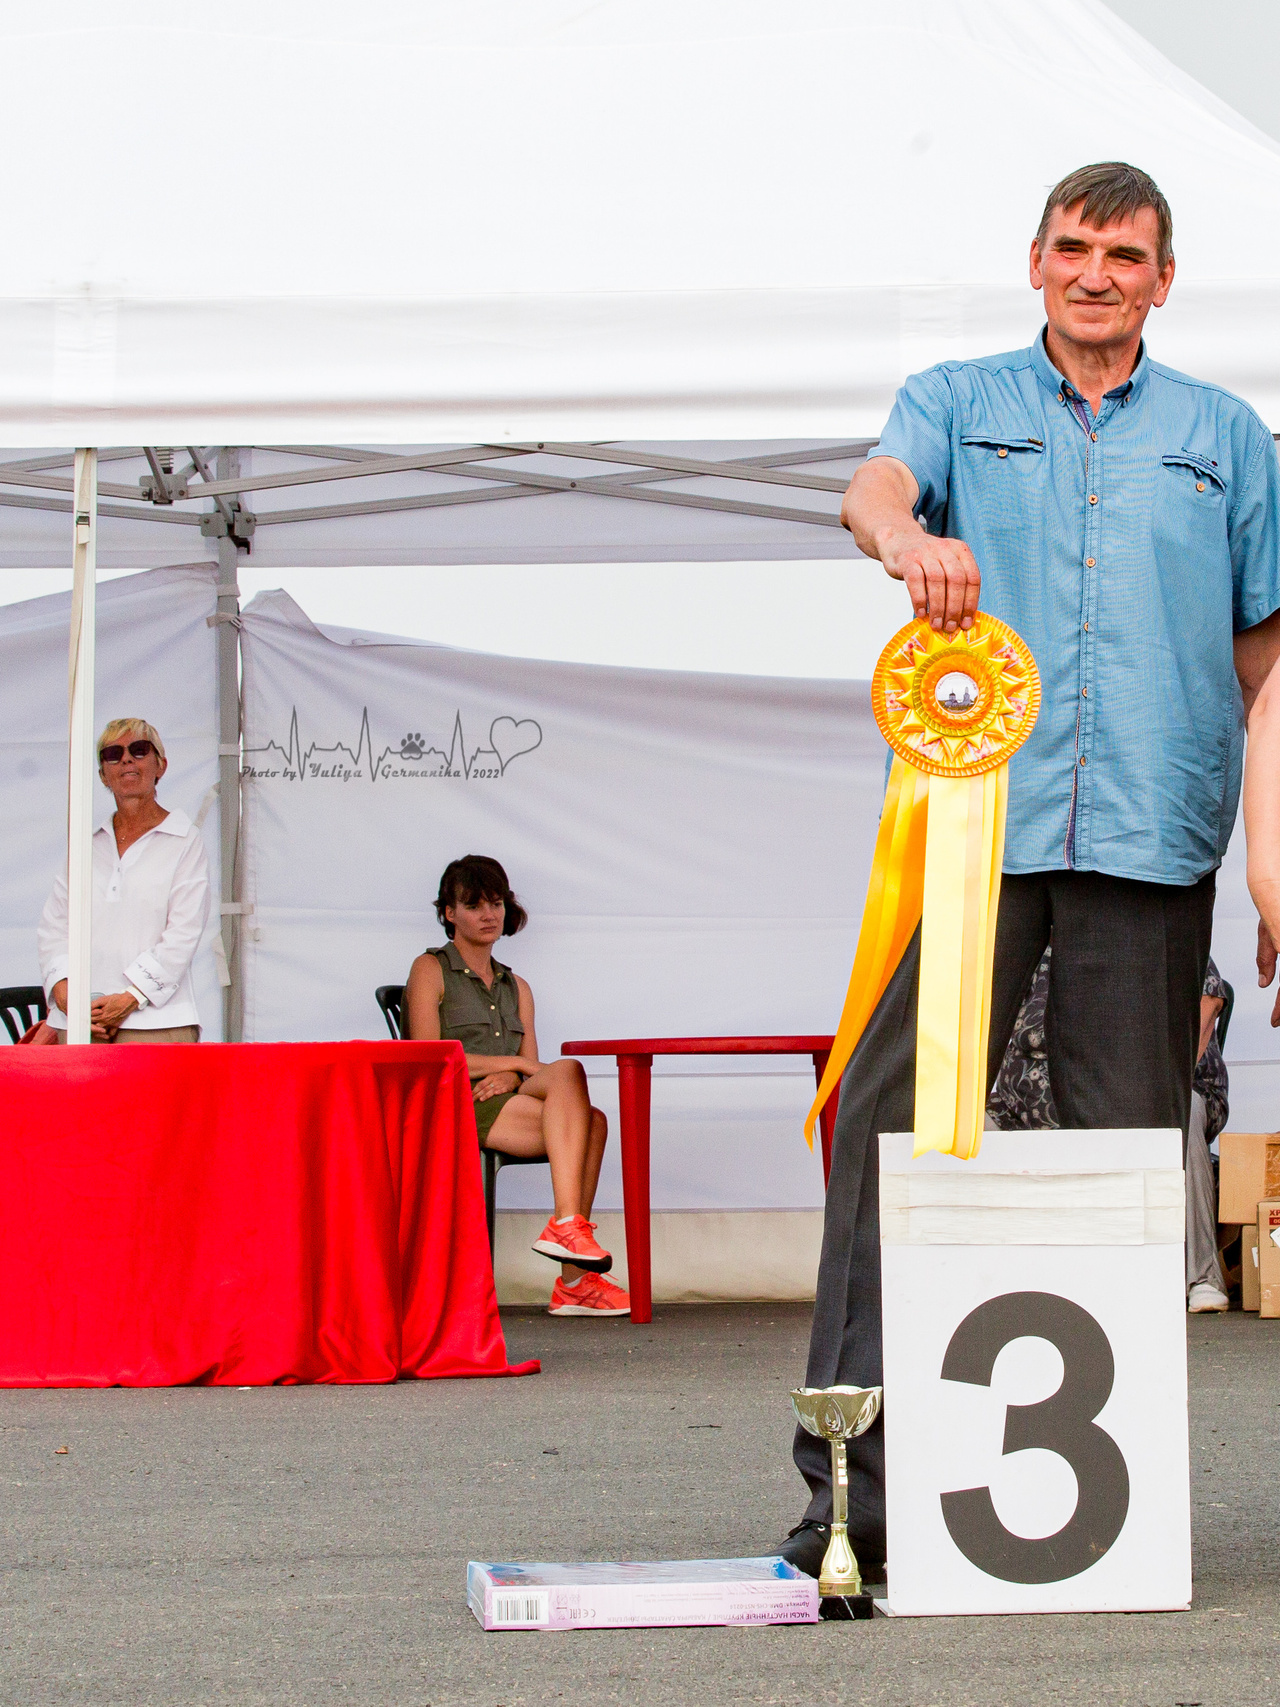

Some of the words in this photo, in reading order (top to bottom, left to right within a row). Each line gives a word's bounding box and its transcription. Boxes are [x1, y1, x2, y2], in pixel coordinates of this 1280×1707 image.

[940, 1290, 1130, 1585] 3
[713, 1613, 744, 1621] КРУГЛЫЕ
[746, 1612, 788, 1620] НАСТЕННЫЕ
